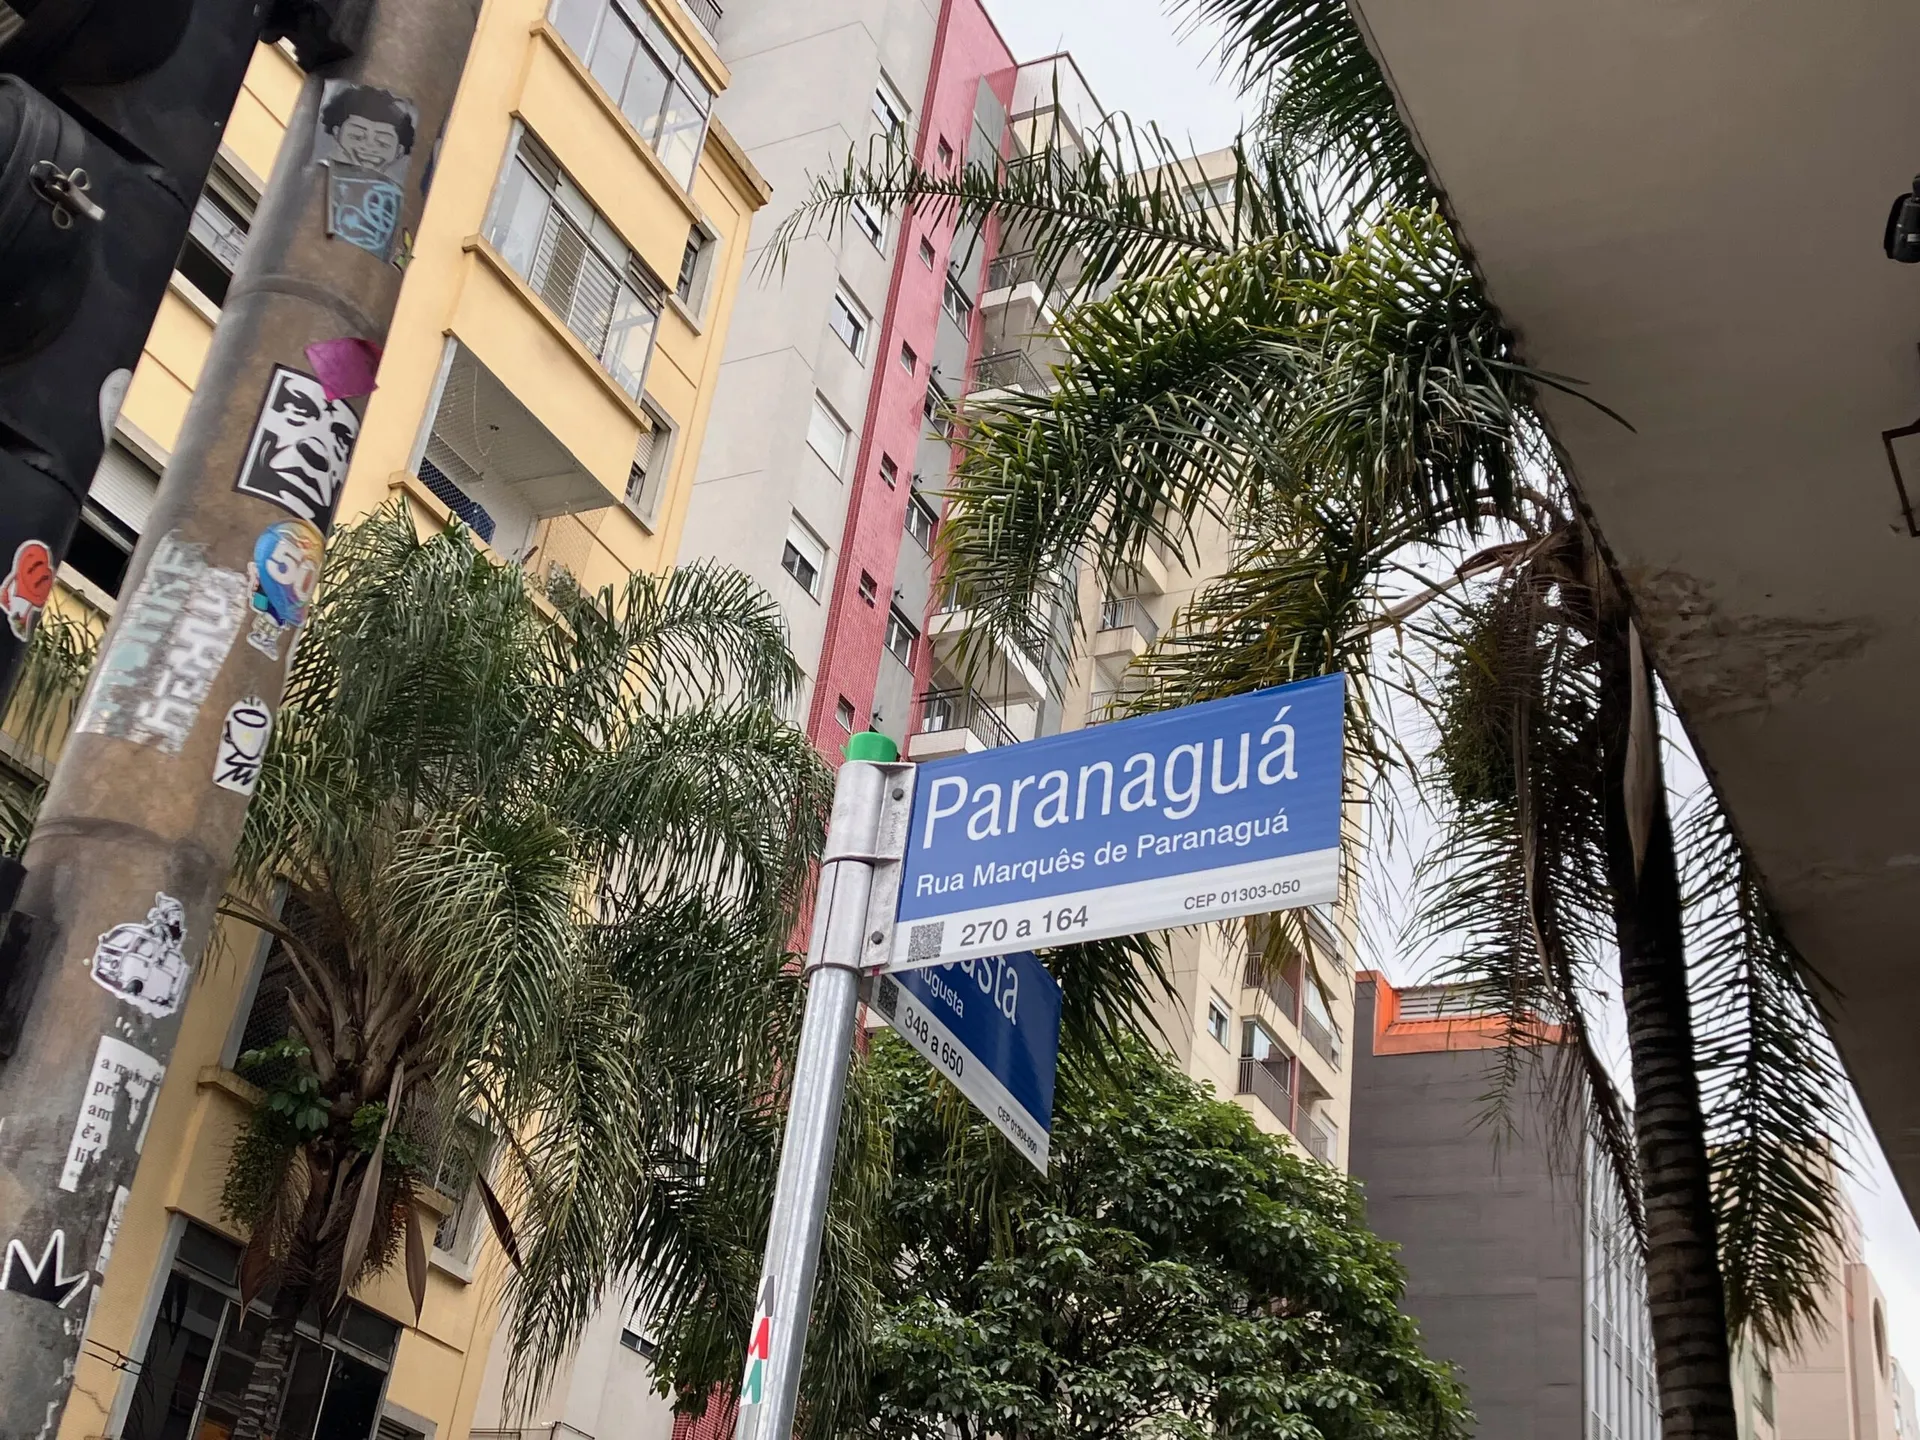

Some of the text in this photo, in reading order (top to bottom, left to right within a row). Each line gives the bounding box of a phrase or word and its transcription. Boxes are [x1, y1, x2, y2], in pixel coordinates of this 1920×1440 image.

[922, 705, 1298, 849] Paranaguá
[916, 808, 1289, 898] Rua Marquês de Paranaguá
[1183, 879, 1301, 911] CEP 01303-050
[959, 905, 1089, 947] 270 a 164
[904, 1006, 964, 1078] 348 a 650
[997, 1106, 1010, 1124] CEP
